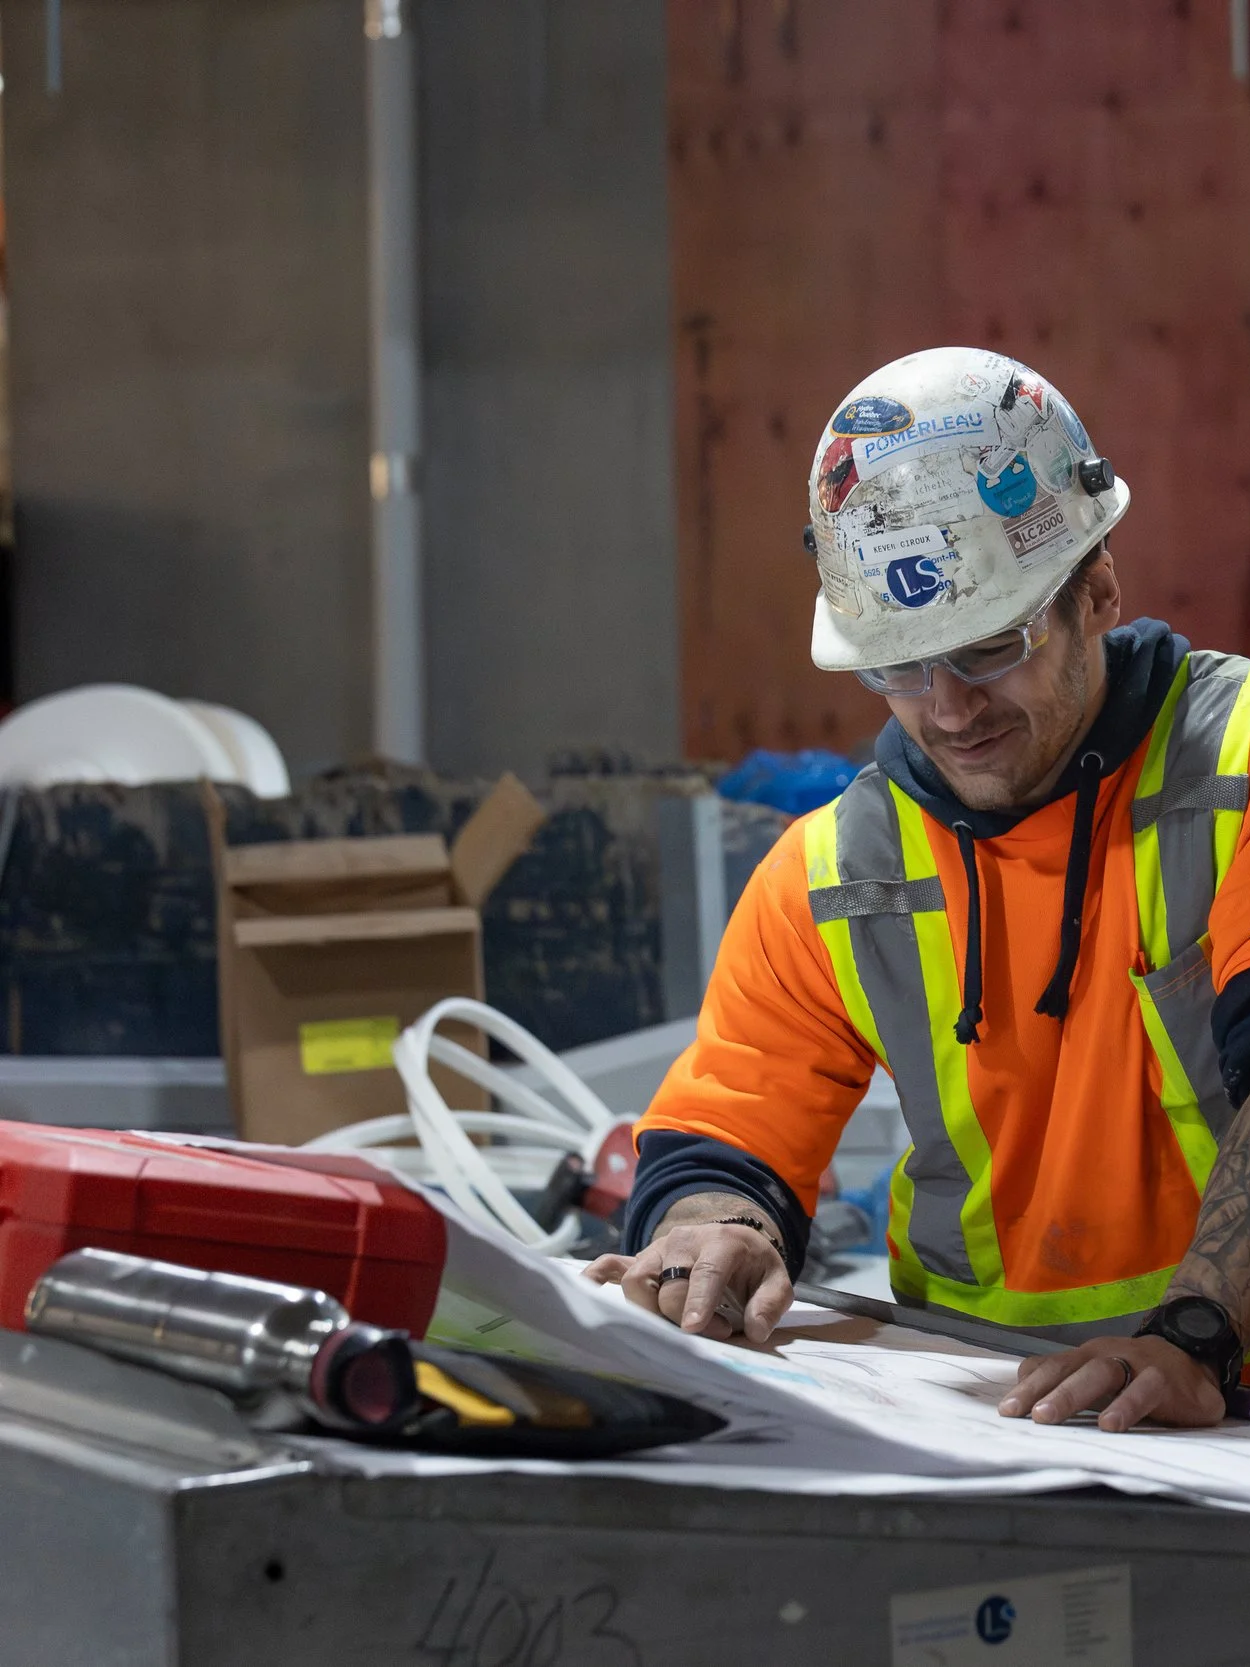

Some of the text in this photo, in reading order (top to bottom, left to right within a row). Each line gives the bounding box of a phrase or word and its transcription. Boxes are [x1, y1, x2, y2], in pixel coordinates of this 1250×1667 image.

[865, 412, 983, 459] POMERLEAU
[873, 535, 931, 554] KEVEN GIROUX
[1021, 512, 1064, 544] LC 2000
[895, 558, 941, 599] LS
